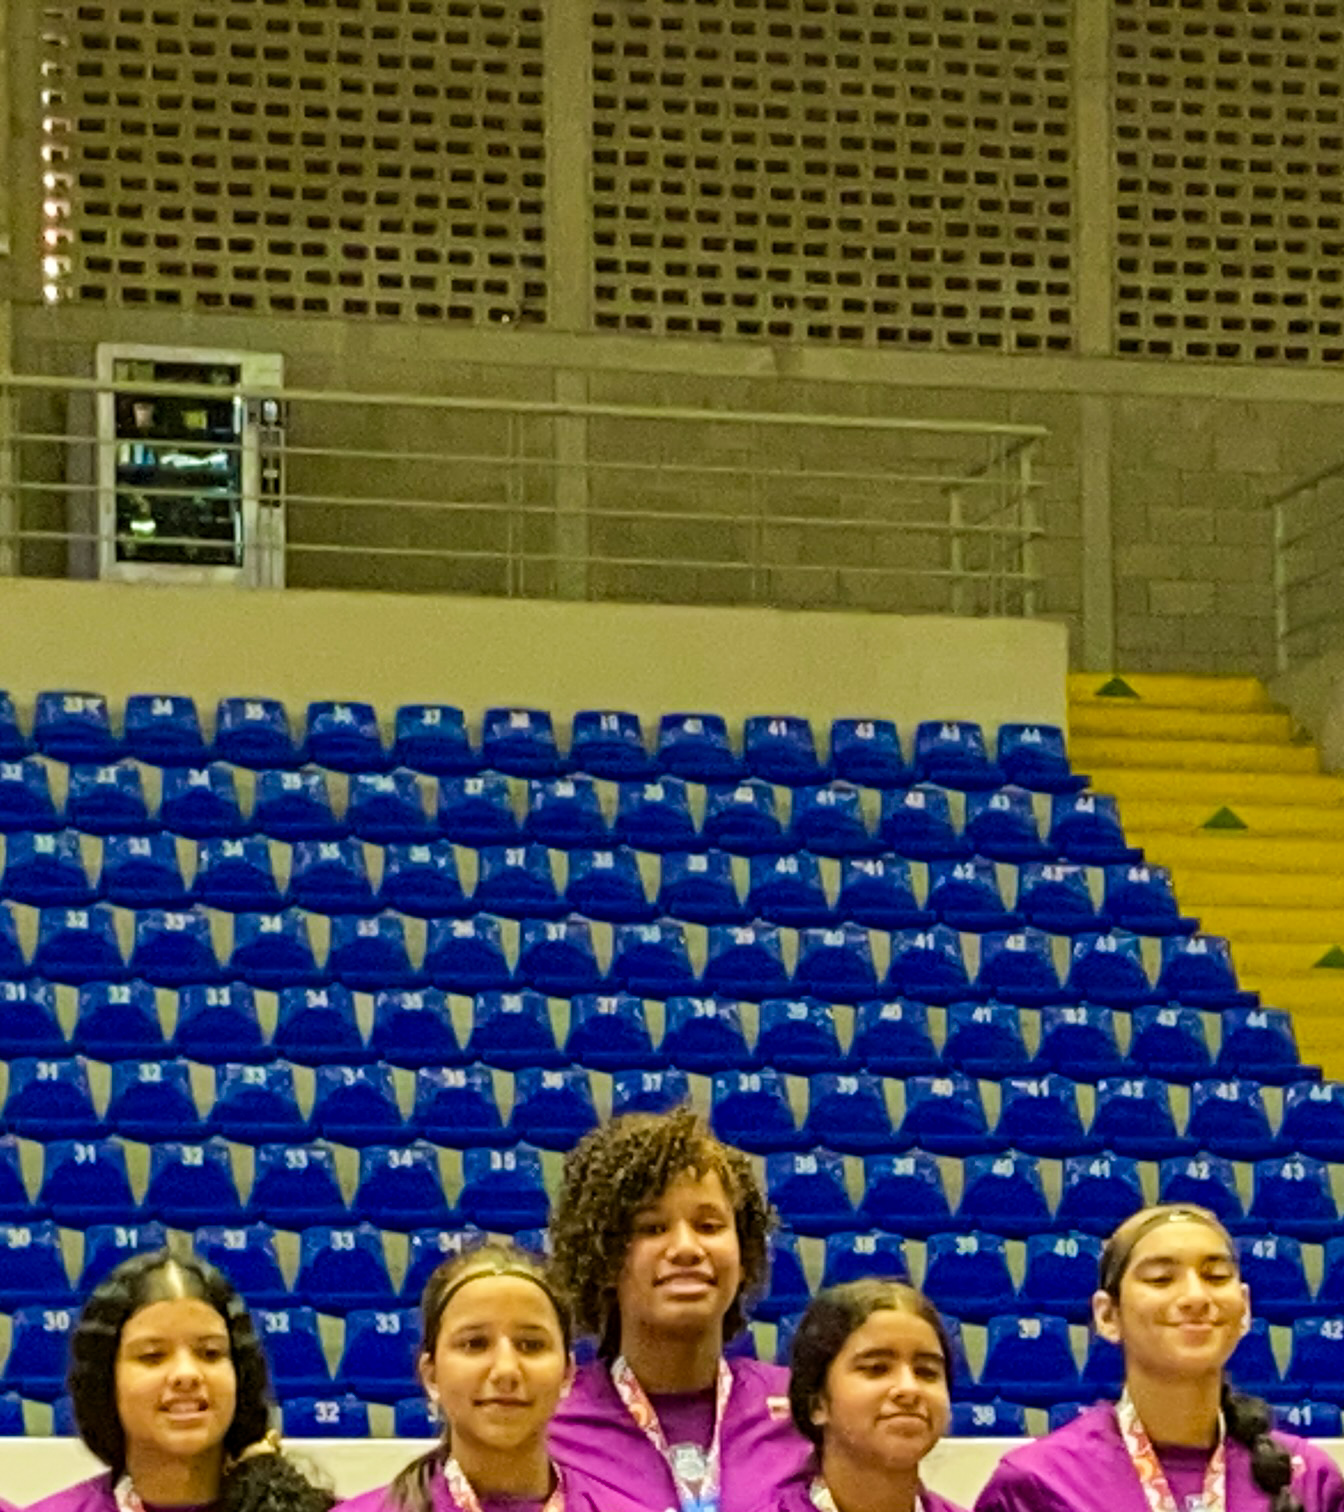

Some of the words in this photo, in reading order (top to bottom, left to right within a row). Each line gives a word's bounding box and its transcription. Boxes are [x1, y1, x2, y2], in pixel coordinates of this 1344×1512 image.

[75, 1143, 95, 1163] 31
[389, 1149, 413, 1168] 34
[1089, 1159, 1110, 1177] 41
[1187, 1160, 1212, 1179] 42
[1281, 1162, 1304, 1180] 43
[115, 1227, 137, 1247] 31
[331, 1231, 355, 1250] 33
[438, 1232, 461, 1252] 34
[1253, 1237, 1278, 1258] 42
[44, 1311, 70, 1331] 30
[376, 1313, 399, 1333] 33
[1321, 1320, 1344, 1339] 42
[315, 1402, 339, 1422] 32
[1288, 1406, 1311, 1425] 41
